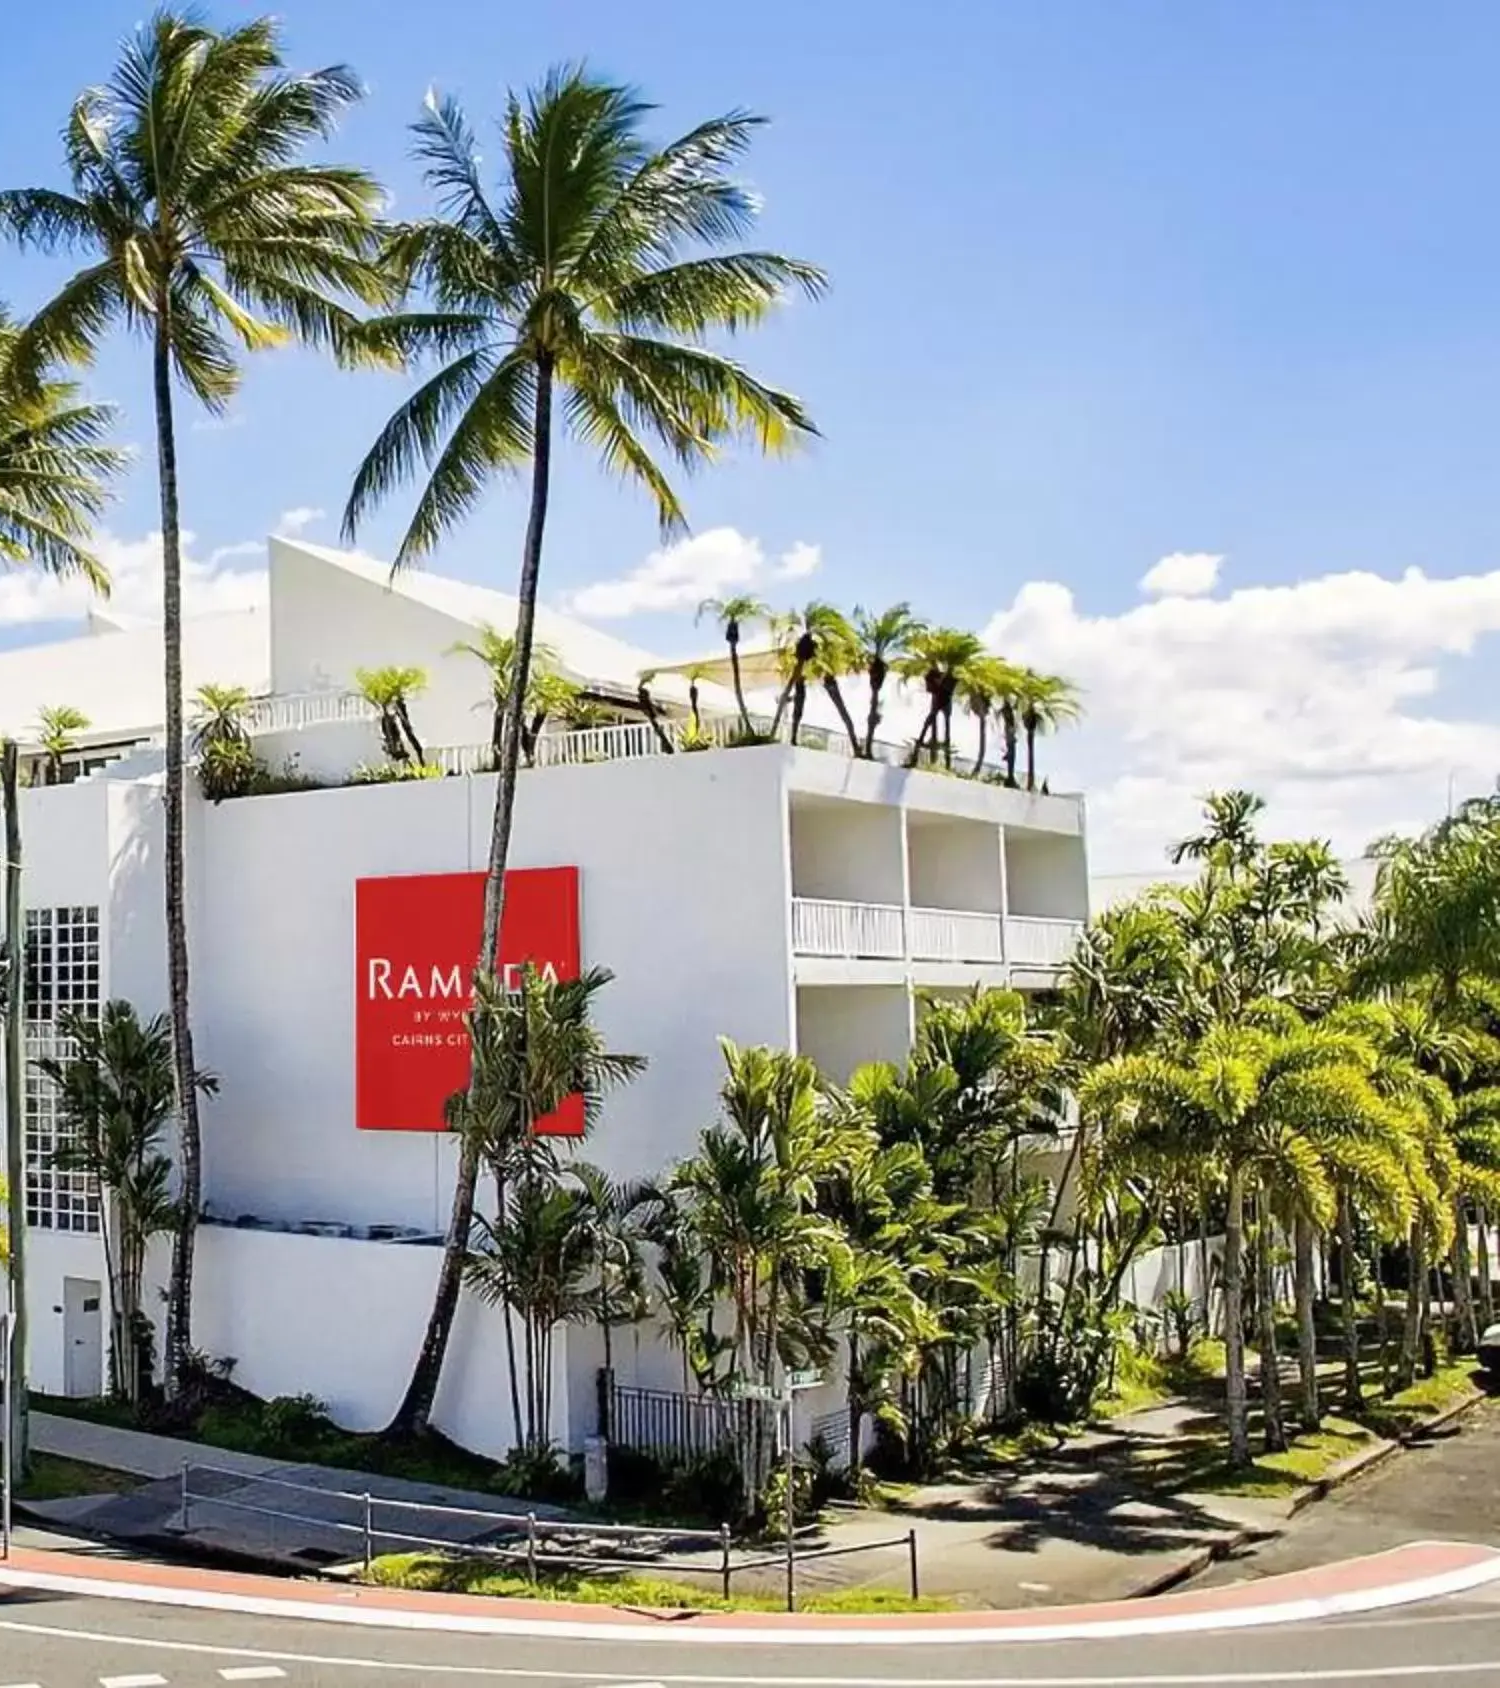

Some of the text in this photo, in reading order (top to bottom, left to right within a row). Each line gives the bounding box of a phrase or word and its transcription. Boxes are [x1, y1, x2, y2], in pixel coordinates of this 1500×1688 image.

[368, 957, 560, 1000] RAMDA
[414, 1010, 430, 1023] BY
[393, 1033, 469, 1046] CAIRNS CIT
